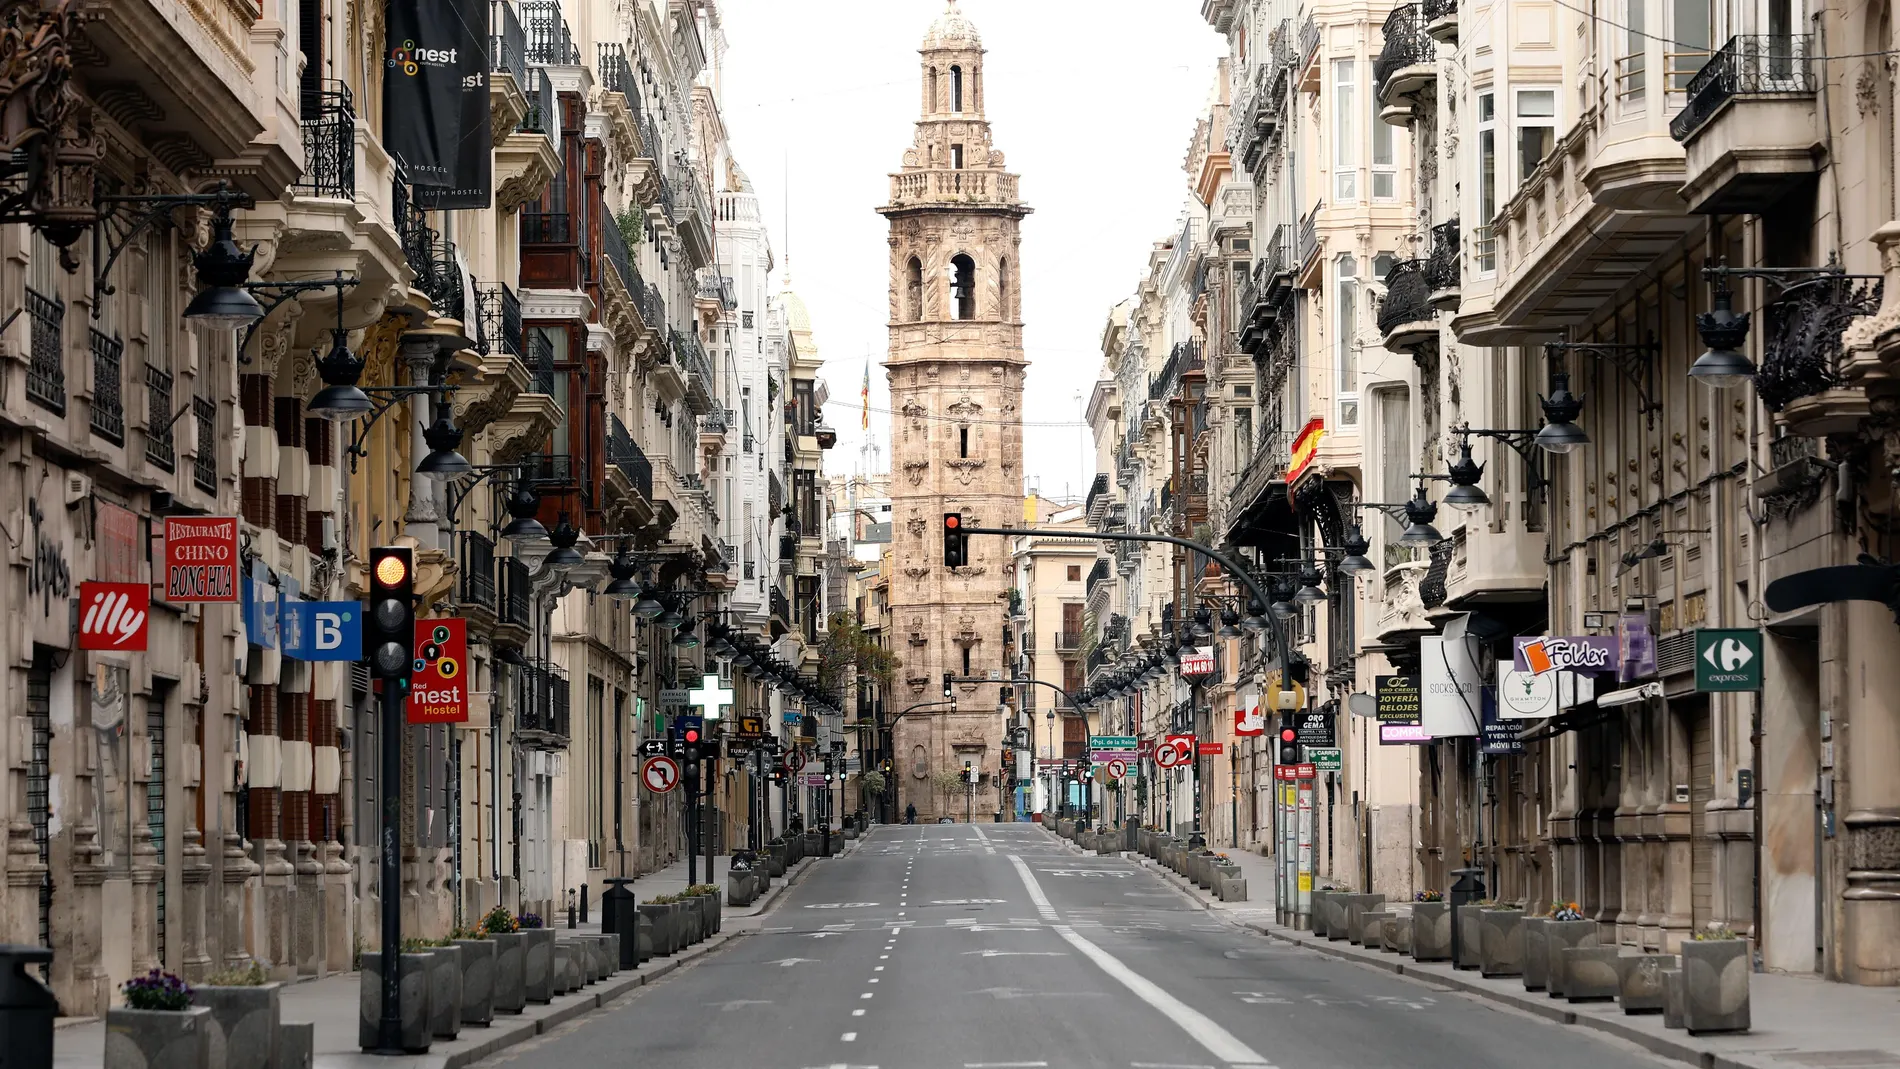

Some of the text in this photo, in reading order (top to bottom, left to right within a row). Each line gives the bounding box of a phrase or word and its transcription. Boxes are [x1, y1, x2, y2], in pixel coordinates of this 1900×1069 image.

[415, 48, 457, 64] nest
[414, 164, 448, 173] HOSTEL
[169, 522, 232, 541] RESTAURANTE
[175, 545, 229, 560] CHINO
[169, 565, 233, 597] RONG HUA
[82, 591, 145, 645] illy
[1543, 640, 1609, 666] Folder
[1708, 674, 1749, 683] express
[414, 686, 461, 704] nest
[1429, 683, 1454, 694] SOCKS
[1379, 694, 1419, 703] JOYERÍA
[424, 705, 460, 715] Hostel
[1307, 714, 1324, 722] ORO
